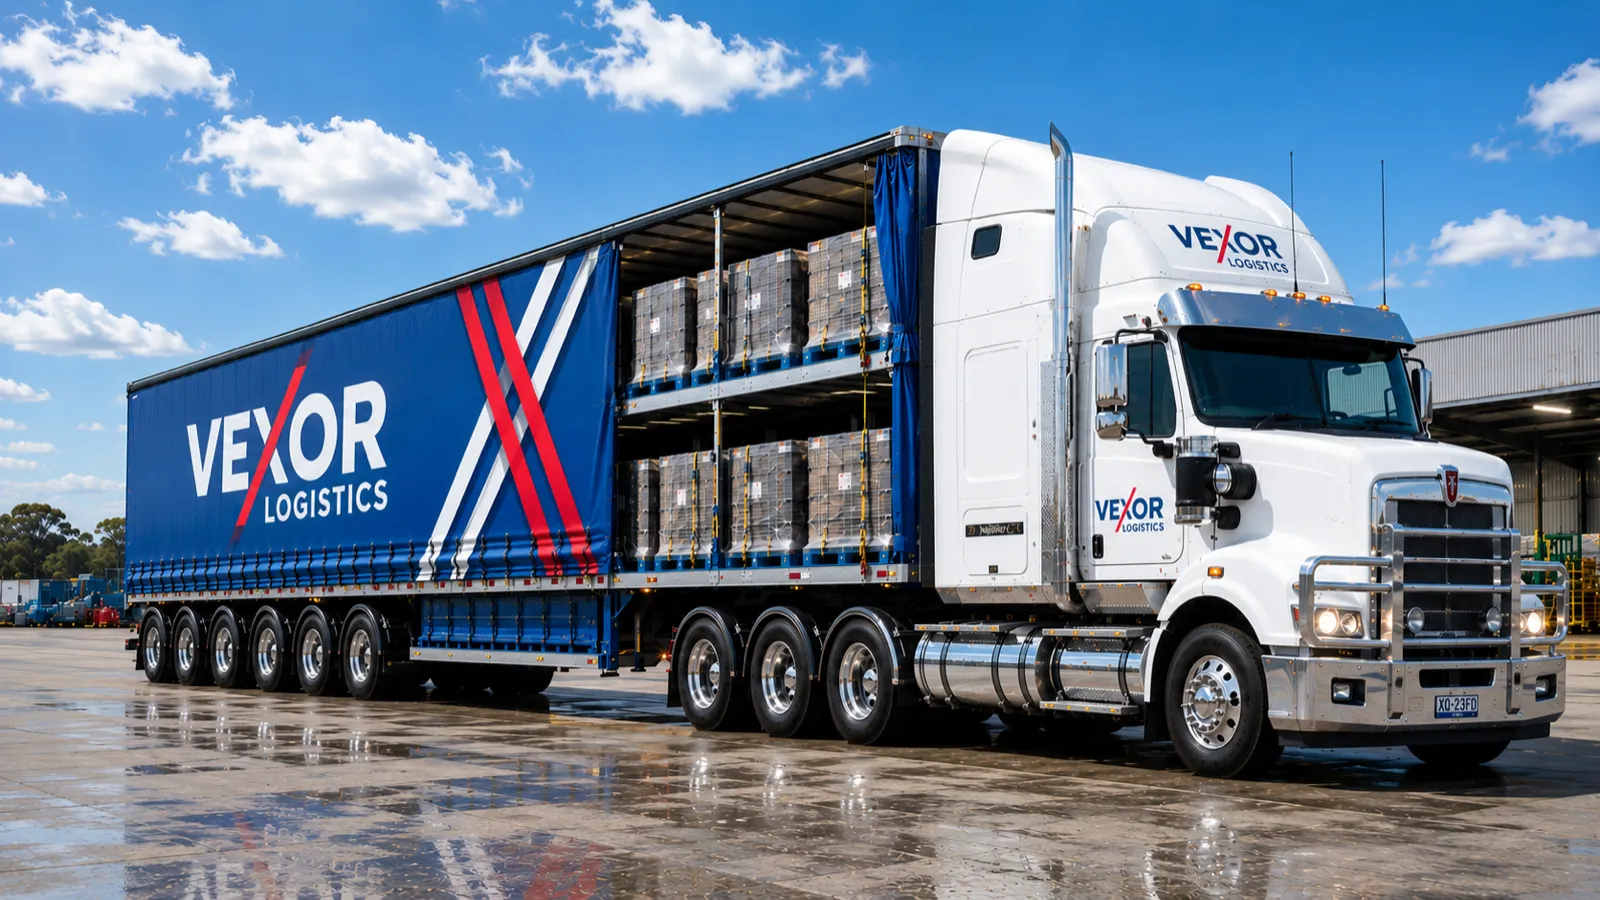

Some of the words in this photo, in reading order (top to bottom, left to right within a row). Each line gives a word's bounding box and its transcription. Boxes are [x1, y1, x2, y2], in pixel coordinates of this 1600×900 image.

[1167, 224, 1283, 263] VEXOR
[1227, 258, 1289, 274] LOGISTICS
[186, 366, 387, 526] VEXOR
[264, 479, 388, 524] LOGISTICS
[1095, 487, 1164, 532] VEXOR
[1122, 522, 1165, 533] LOGISTICS
